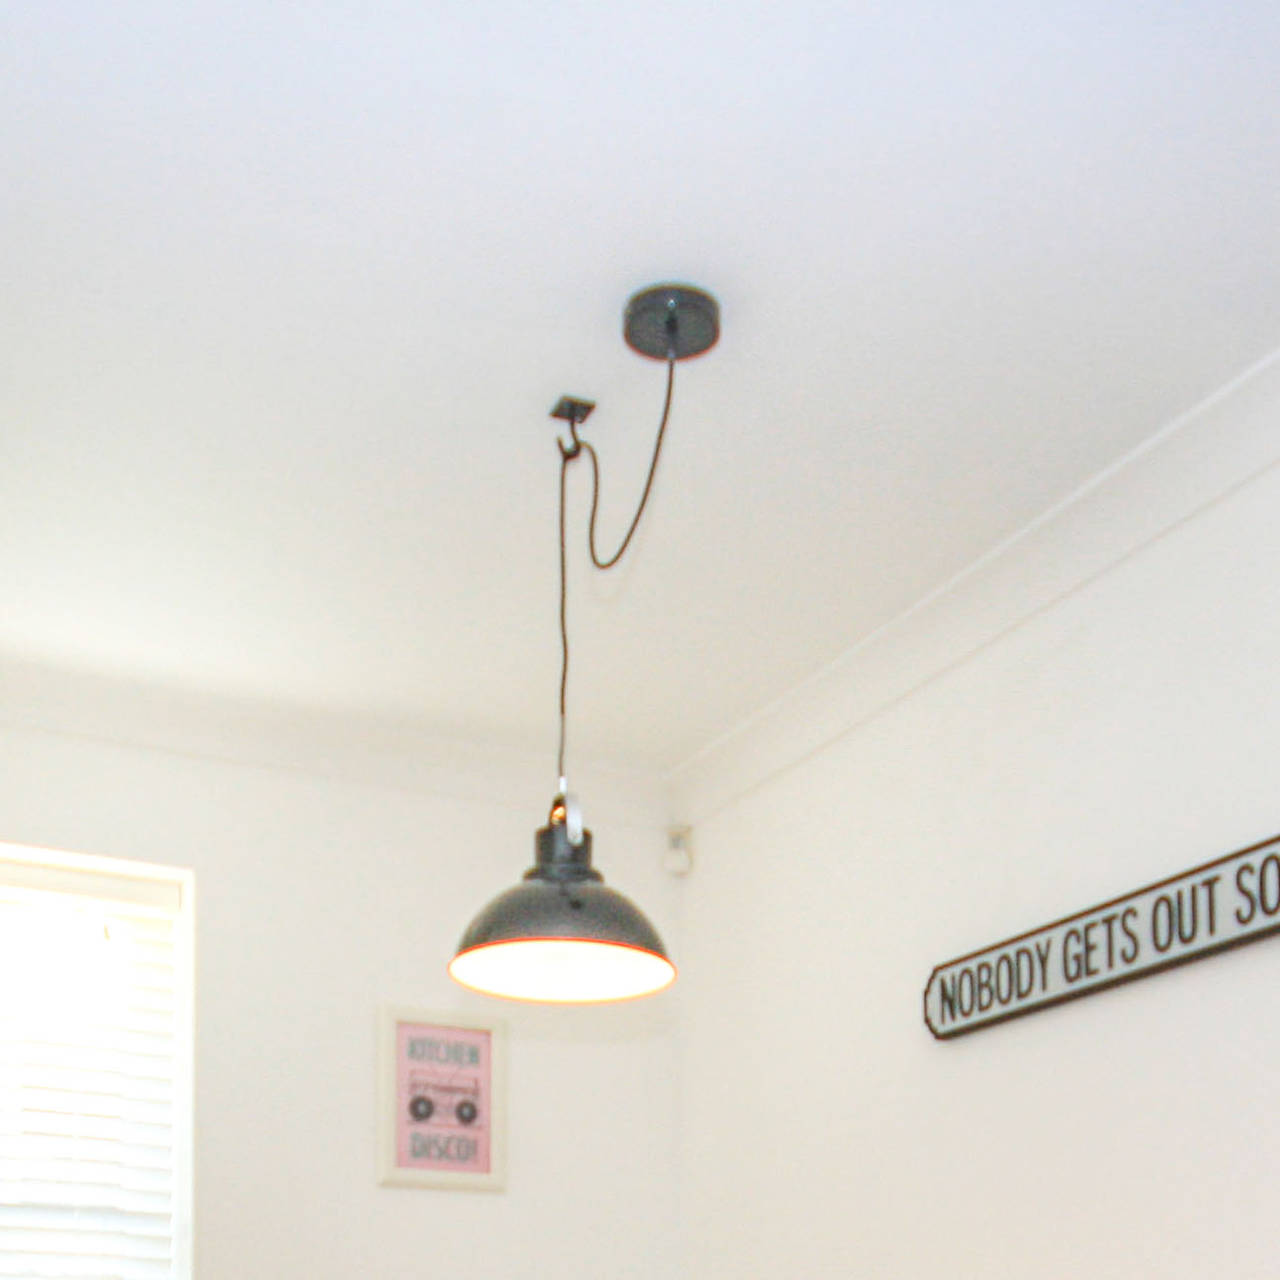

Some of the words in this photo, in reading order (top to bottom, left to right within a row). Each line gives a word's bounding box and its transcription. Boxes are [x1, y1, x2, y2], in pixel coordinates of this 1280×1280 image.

[939, 937, 1052, 1025] NOBODY
[1063, 907, 1140, 983] GETS
[1151, 874, 1222, 953] OUT
[408, 1037, 479, 1067] KITCHEN
